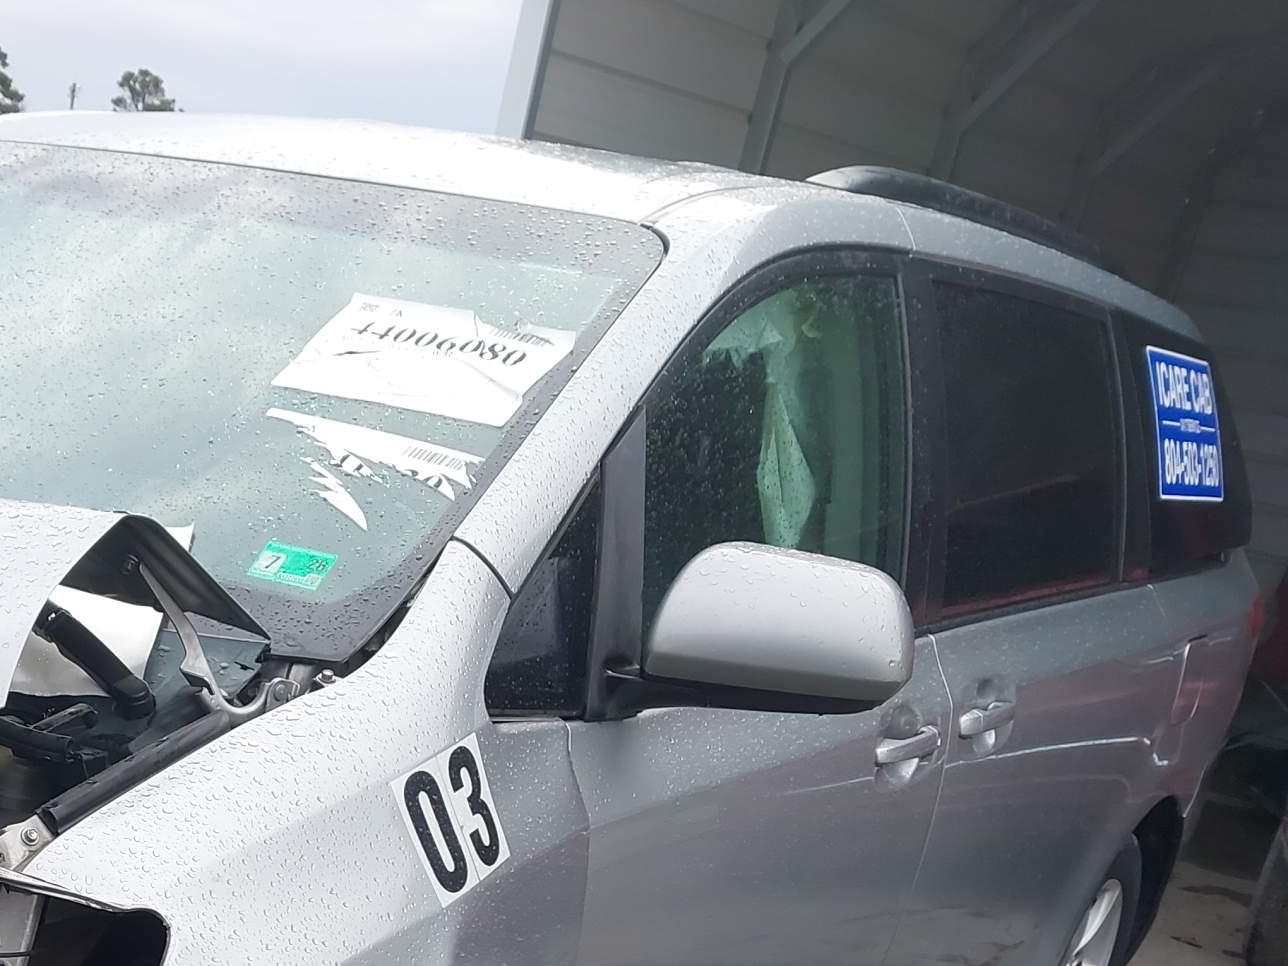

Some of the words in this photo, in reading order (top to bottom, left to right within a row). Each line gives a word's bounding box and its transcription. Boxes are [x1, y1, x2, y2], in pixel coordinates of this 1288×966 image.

[1156, 361, 1191, 411] ICARE
[1190, 370, 1212, 415] CAB
[264, 554, 281, 570] 7
[404, 745, 500, 893] 03
